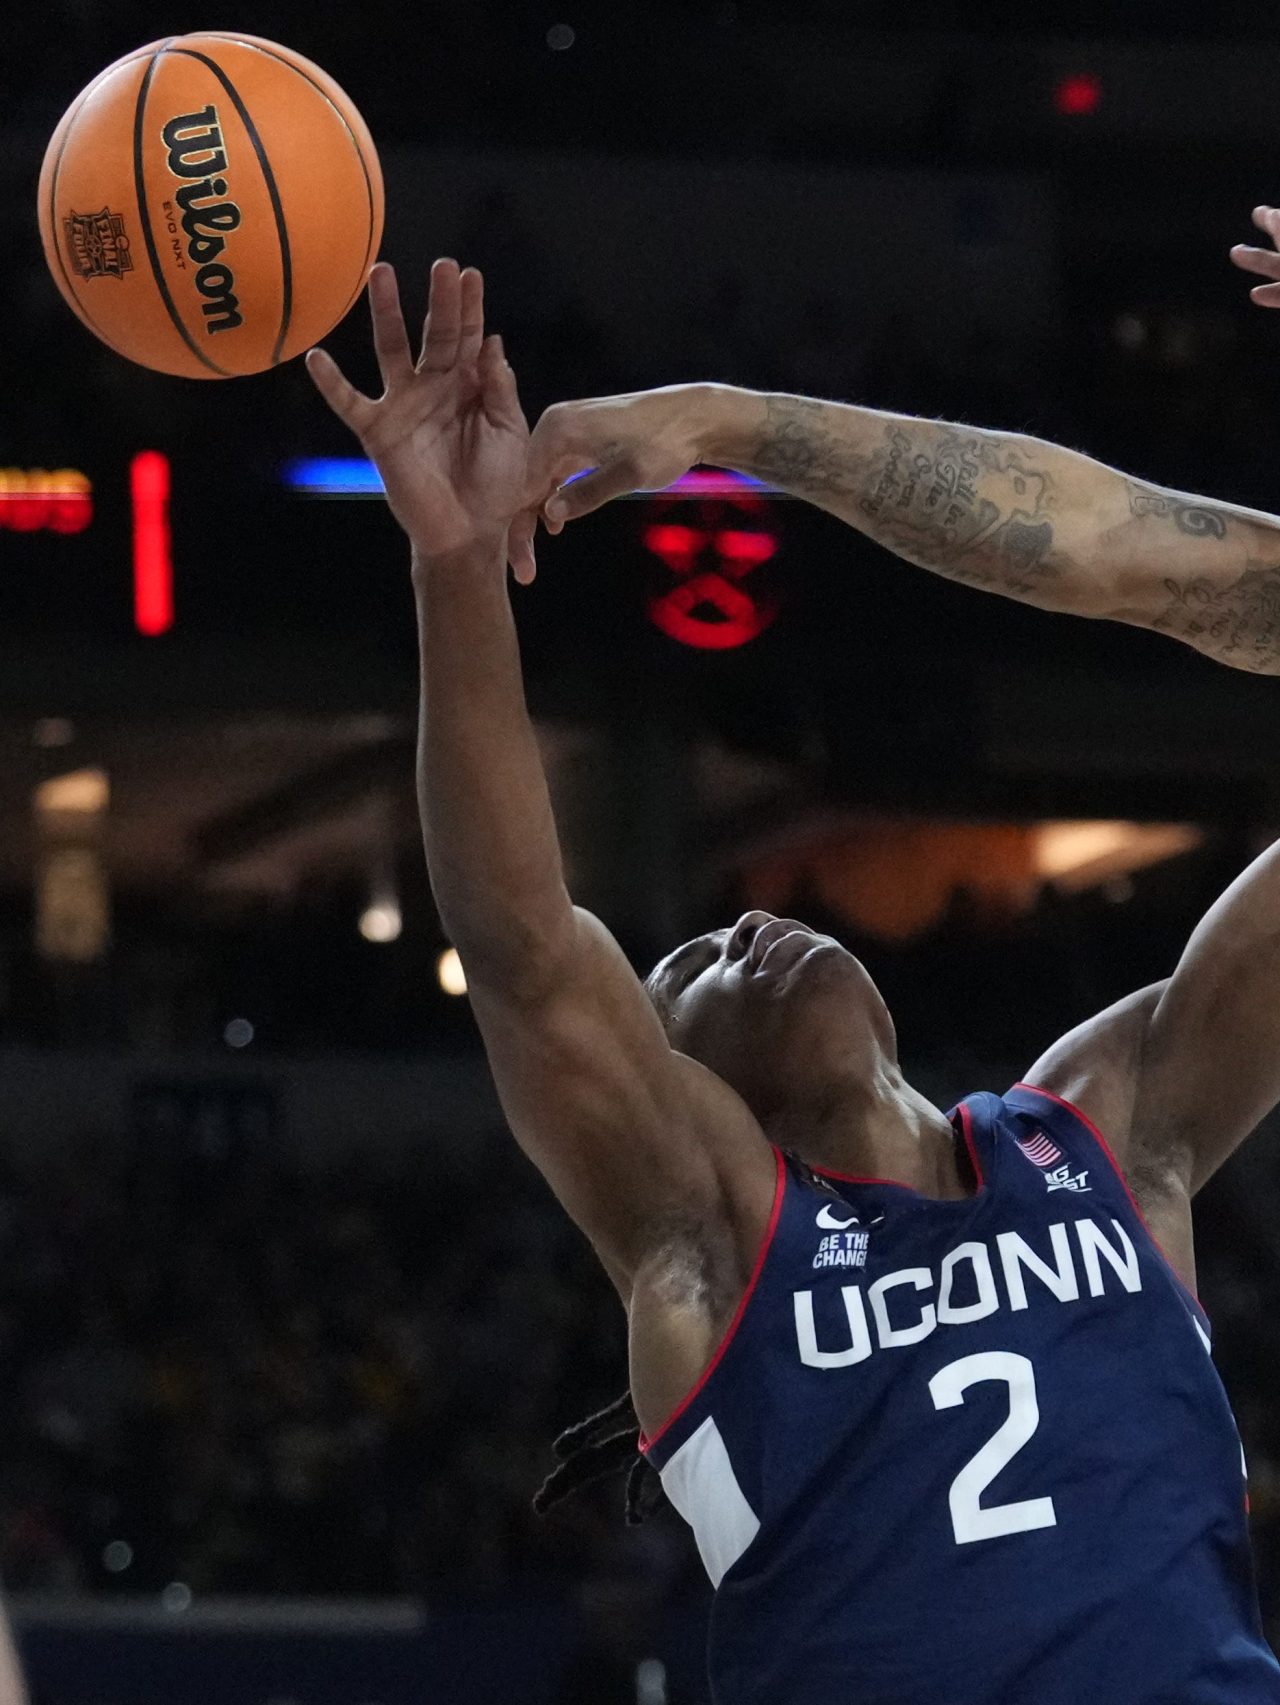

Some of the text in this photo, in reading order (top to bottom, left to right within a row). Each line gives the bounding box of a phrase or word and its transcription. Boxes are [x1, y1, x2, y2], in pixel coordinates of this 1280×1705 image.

[96, 218, 118, 269] FINAL
[161, 105, 244, 335] Wilson
[163, 200, 187, 270] EVO NXT
[793, 1218, 1142, 1369] UCONN
[818, 1233, 840, 1252] BE
[928, 1351, 1057, 1545] 2
